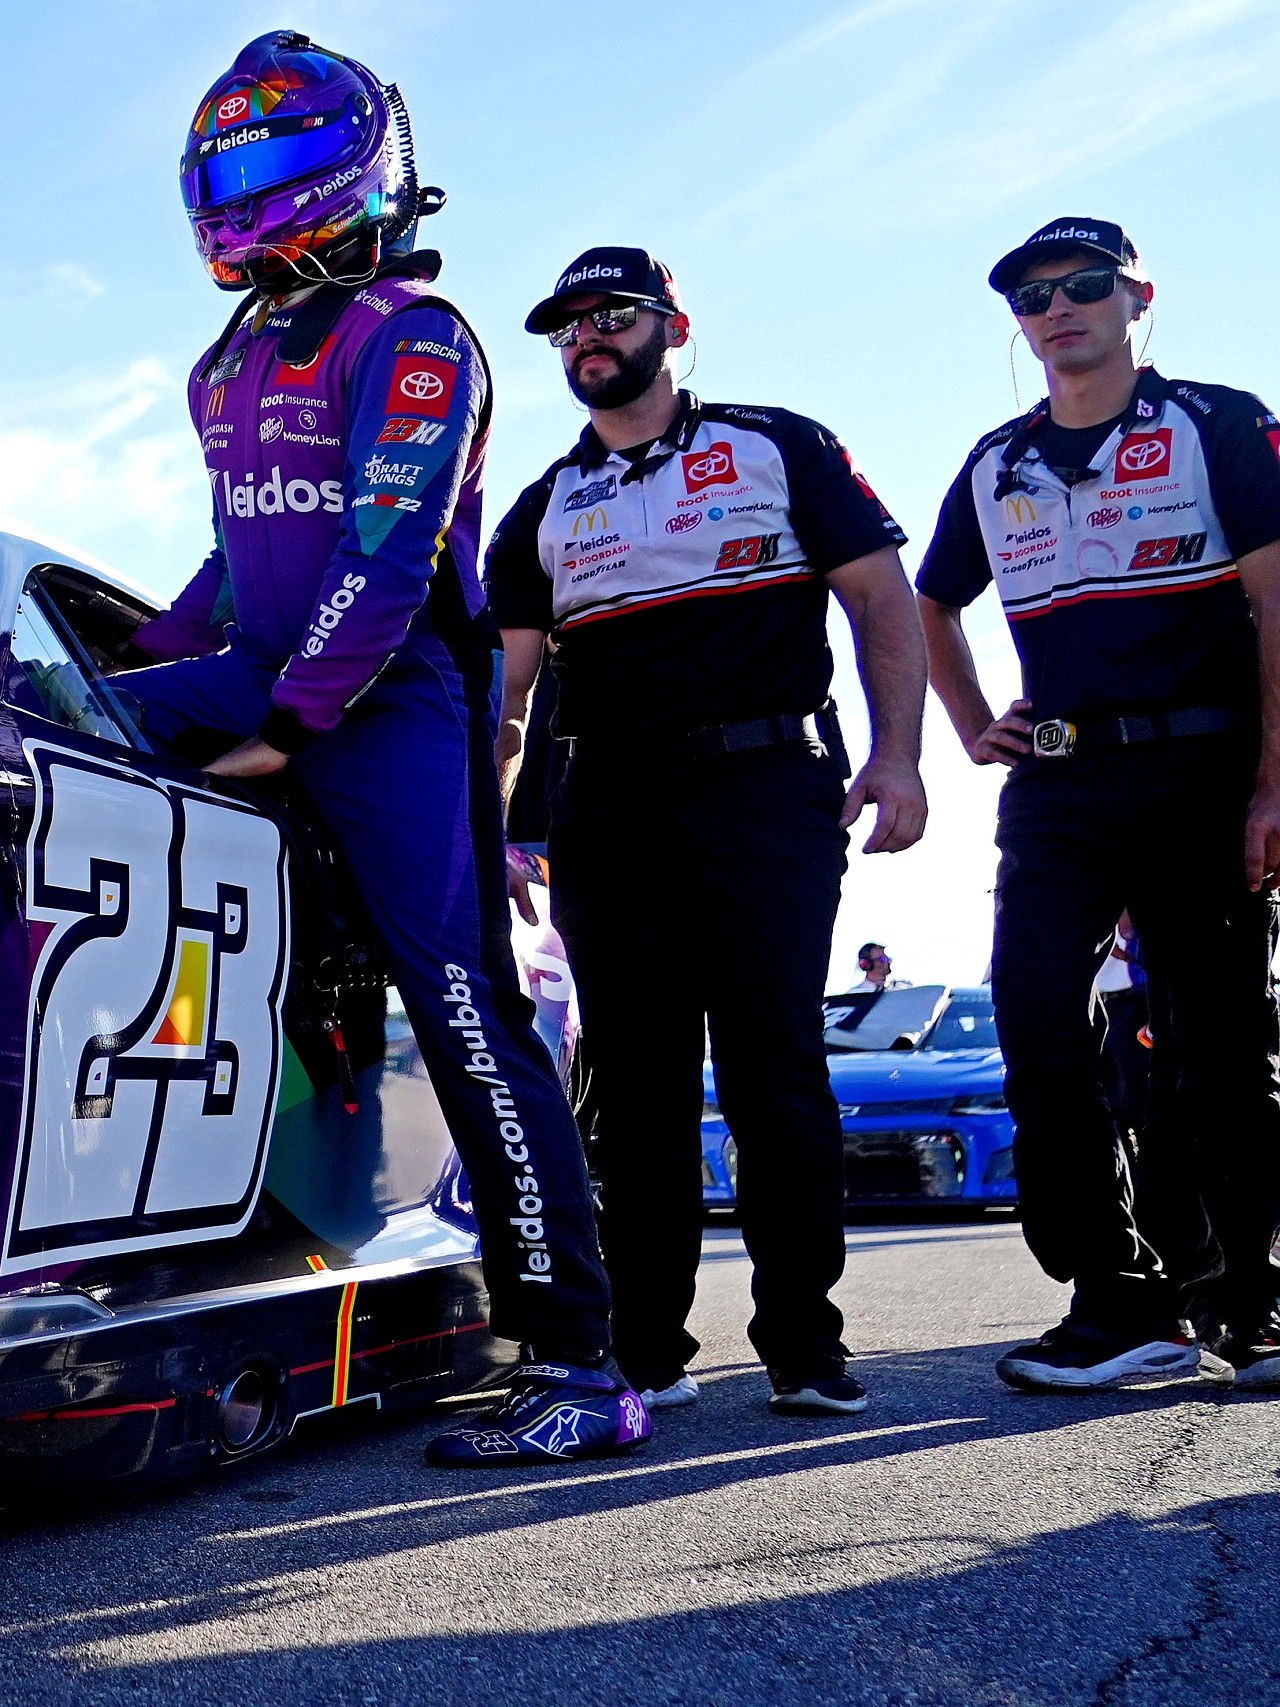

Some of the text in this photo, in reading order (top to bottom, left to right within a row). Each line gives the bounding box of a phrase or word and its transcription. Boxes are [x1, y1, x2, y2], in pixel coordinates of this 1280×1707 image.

[216, 127, 270, 153] leidos
[314, 165, 362, 201] leidos
[567, 263, 623, 287] leidos
[412, 341, 462, 364] NASCAR
[285, 394, 328, 409] Insurance
[283, 431, 341, 447] MoneyLion
[375, 418, 449, 447] 23XI
[365, 463, 424, 478] DRAFT
[369, 473, 417, 487] KINGS
[223, 465, 345, 518] leidos
[676, 493, 709, 509] Root
[1100, 483, 1181, 501] Root Insurance
[728, 502, 774, 515] MoneyLion
[1147, 499, 1198, 515] MoneyLion
[579, 533, 621, 552] leidos
[1014, 525, 1052, 545] leidos
[579, 543, 631, 566] DOORDASH
[713, 531, 783, 572] 23XI
[1127, 530, 1208, 572] 23XI
[1002, 552, 1057, 574] GOODYEAR
[0, 737, 291, 1277] 23
[444, 962, 553, 1283] leidos.com/bubba
